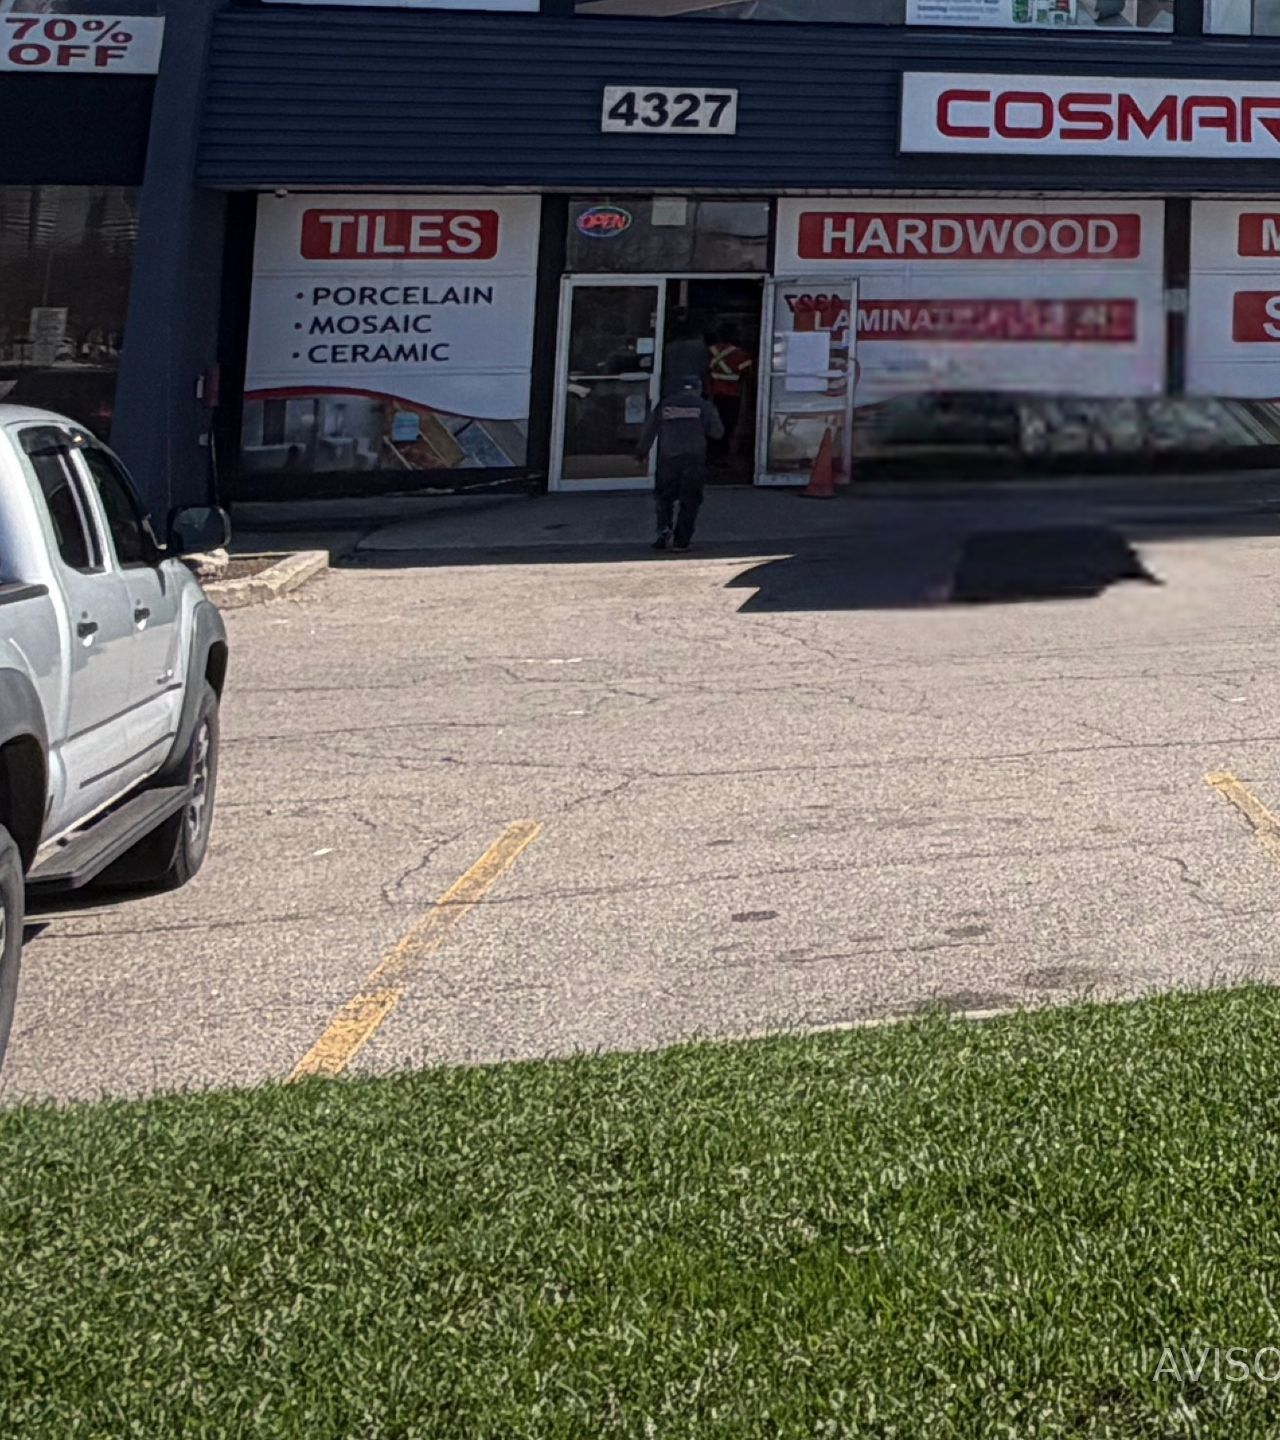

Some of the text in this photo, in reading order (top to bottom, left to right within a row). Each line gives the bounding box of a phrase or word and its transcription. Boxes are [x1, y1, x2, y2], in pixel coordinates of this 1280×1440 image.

[5, 17, 133, 43] 70%
[8, 43, 128, 67] OFF
[608, 93, 733, 128] 4327
[582, 213, 627, 230] OPEN
[319, 214, 484, 254] TILES
[821, 217, 1119, 254] HARDWOOD
[312, 285, 494, 306] PORCELAIN
[308, 314, 432, 335] MOSAIC
[307, 343, 450, 364] CERAMIC
